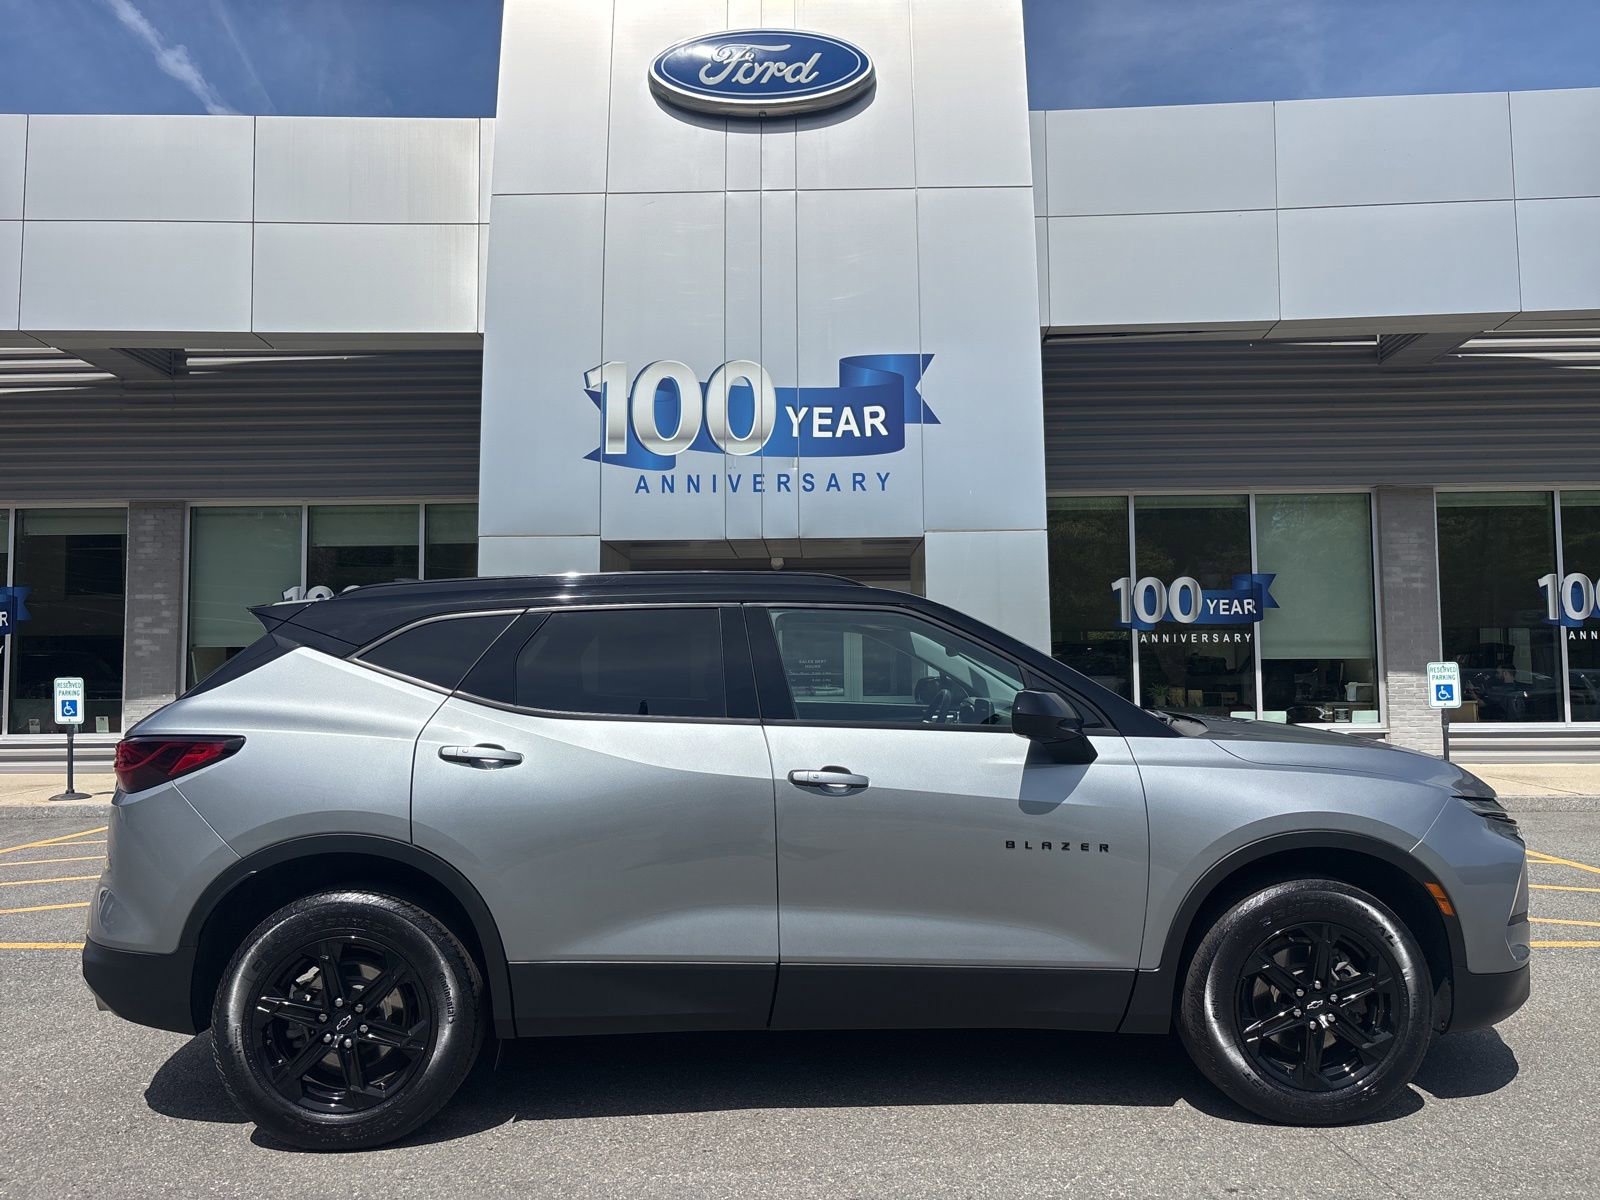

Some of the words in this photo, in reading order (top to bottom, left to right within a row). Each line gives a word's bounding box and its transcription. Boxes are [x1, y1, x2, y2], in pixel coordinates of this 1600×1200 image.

[699, 43, 823, 85] Ford
[583, 359, 777, 457] 100
[784, 405, 890, 438] YEAR
[634, 471, 891, 495] ANNIVERSARY
[1111, 576, 1203, 624] 100
[1206, 598, 1258, 615] YEAR
[1537, 572, 1600, 620] 10
[1140, 633, 1252, 643] ANNIVERSARY
[1005, 840, 1109, 853] BLAZER
